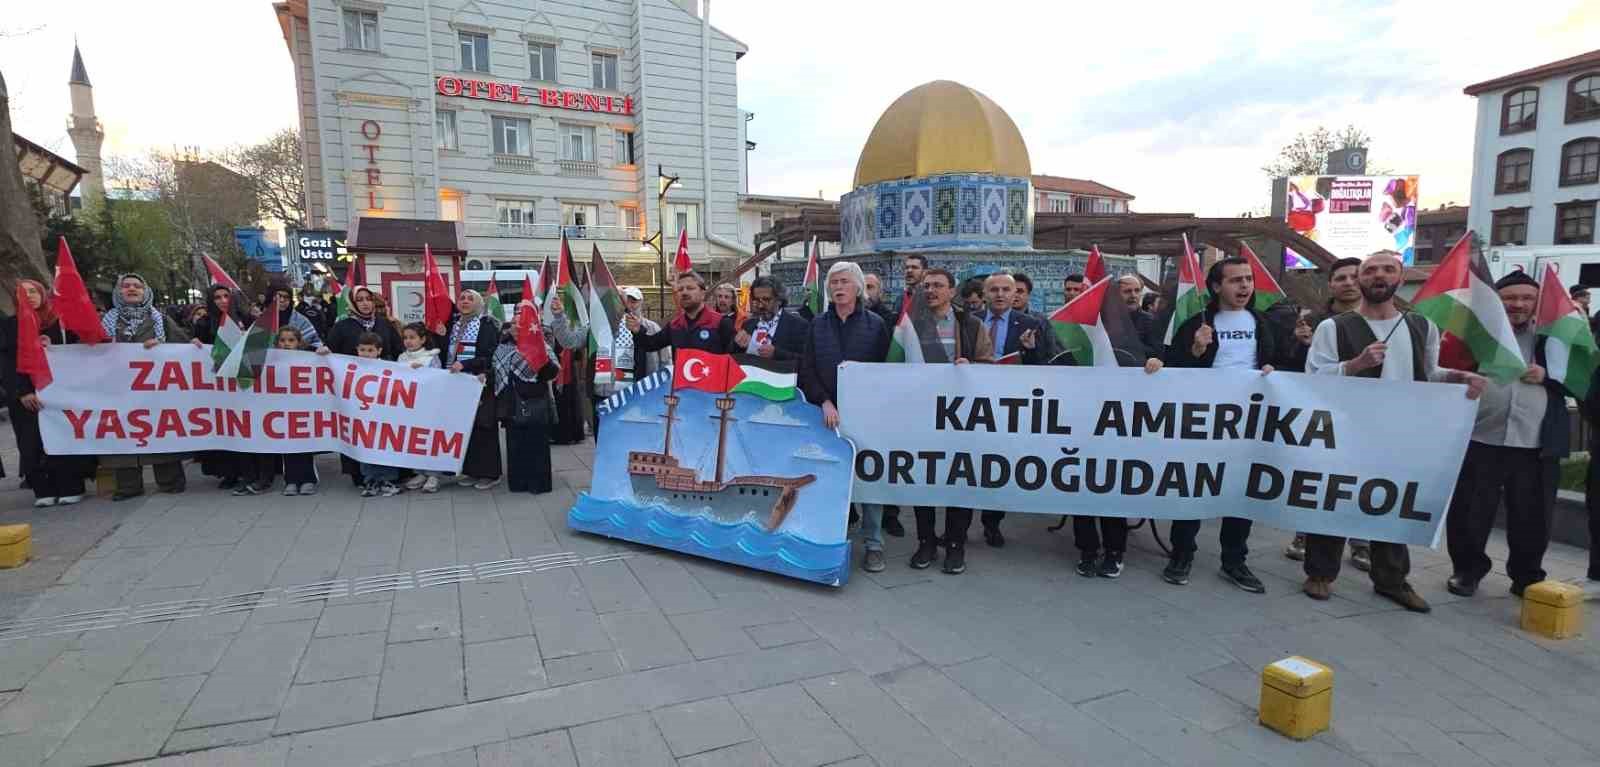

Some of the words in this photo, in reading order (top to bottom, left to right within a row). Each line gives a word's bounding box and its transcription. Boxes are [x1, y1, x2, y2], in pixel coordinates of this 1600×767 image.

[437, 76, 529, 104] OTEL
[361, 119, 384, 209] OTEL
[300, 237, 331, 248] Gazi
[300, 249, 333, 260] Usta
[342, 363, 418, 411] İÇİN
[62, 408, 252, 448] YAŞASIN
[262, 410, 464, 460] CEHENNEM
[935, 388, 1072, 435] KATİL
[1093, 393, 1337, 450] AMERİKA
[854, 447, 1226, 497] ORTADOĞUDAN
[1245, 462, 1433, 522] DEFOL
